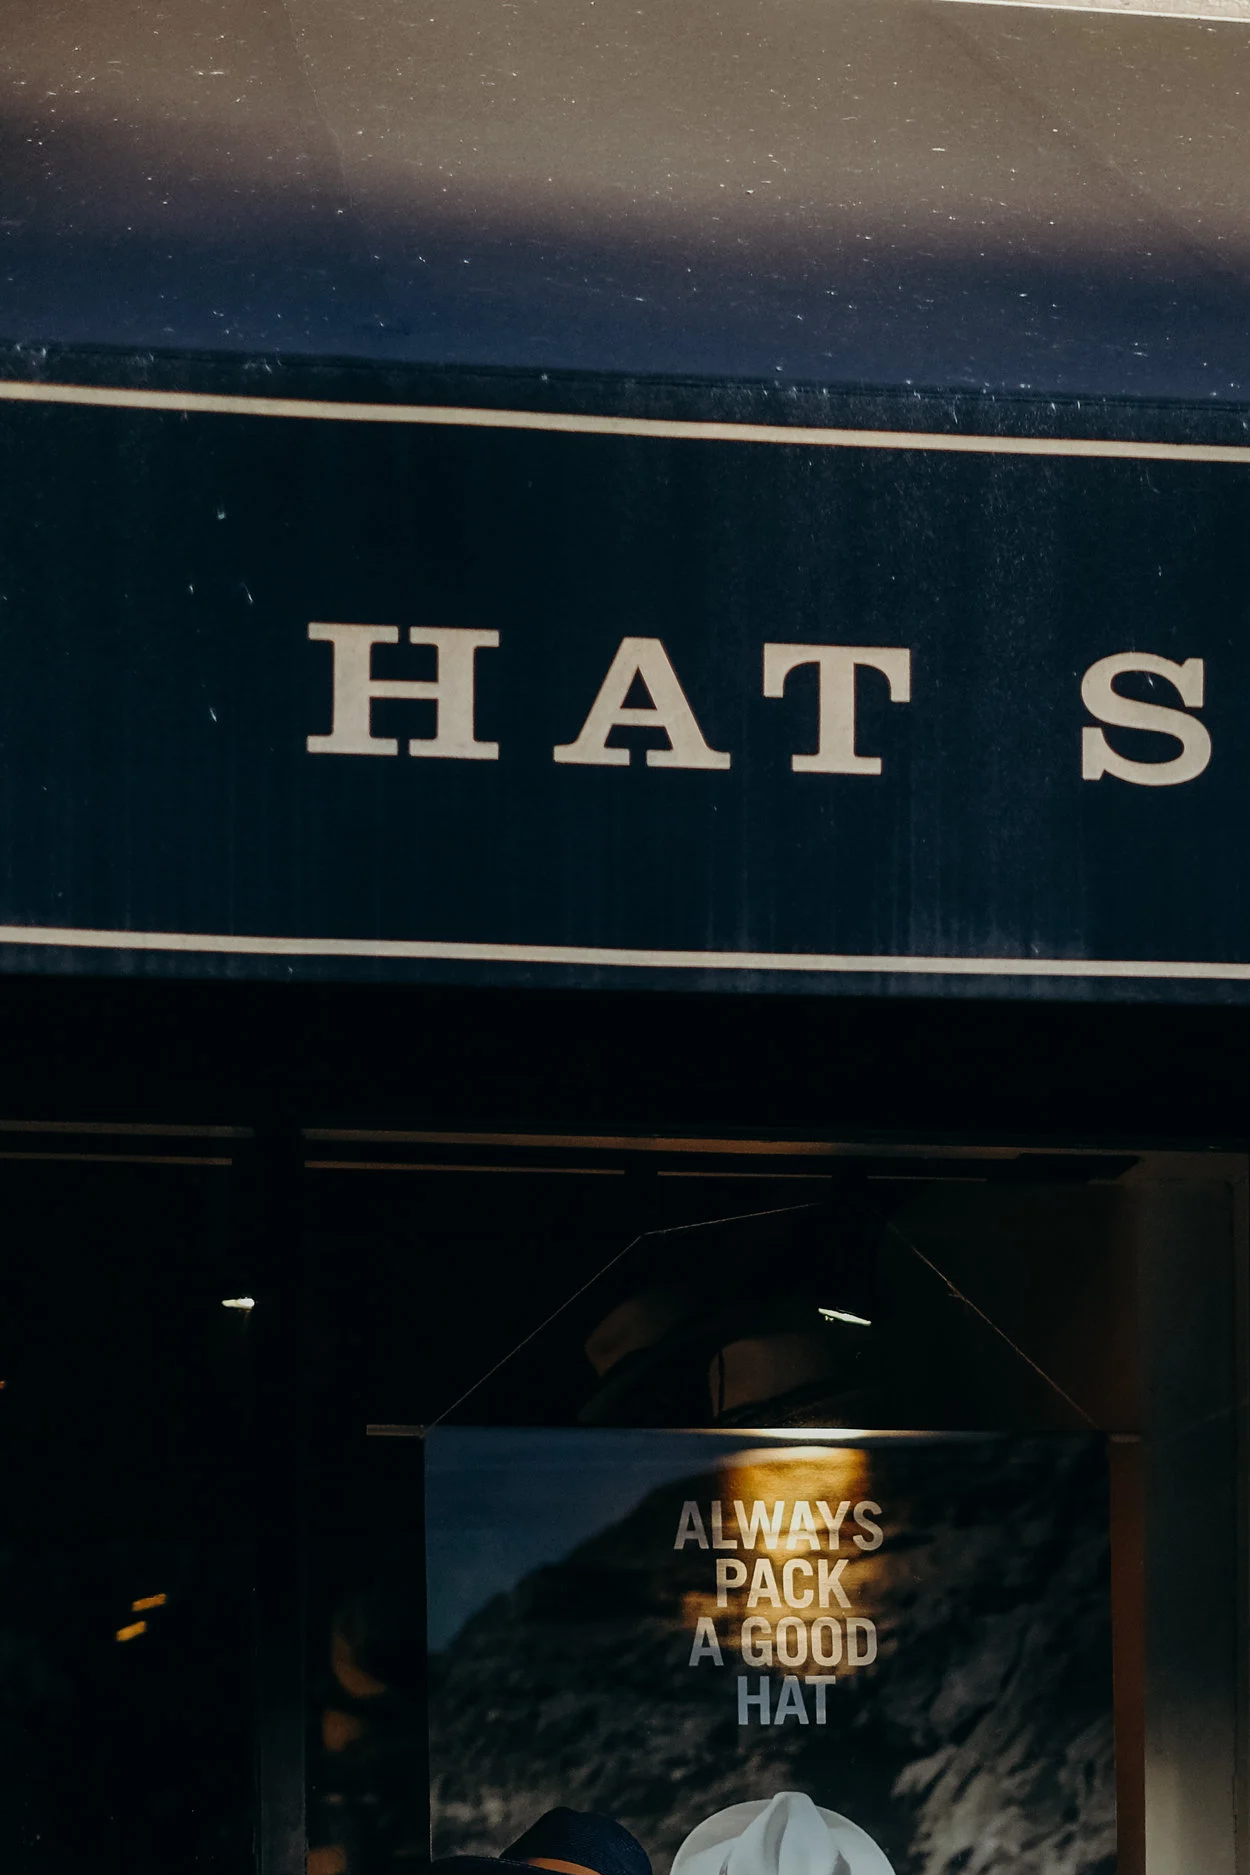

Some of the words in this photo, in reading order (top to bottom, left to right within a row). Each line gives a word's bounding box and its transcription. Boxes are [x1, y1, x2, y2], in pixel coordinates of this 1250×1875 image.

[306, 621, 912, 776] HAT
[673, 1500, 884, 1551] ALWAYS
[716, 1558, 852, 1609] PACK
[688, 1616, 724, 1667] A
[740, 1616, 878, 1667] GOOD
[737, 1675, 836, 1726] HAT
